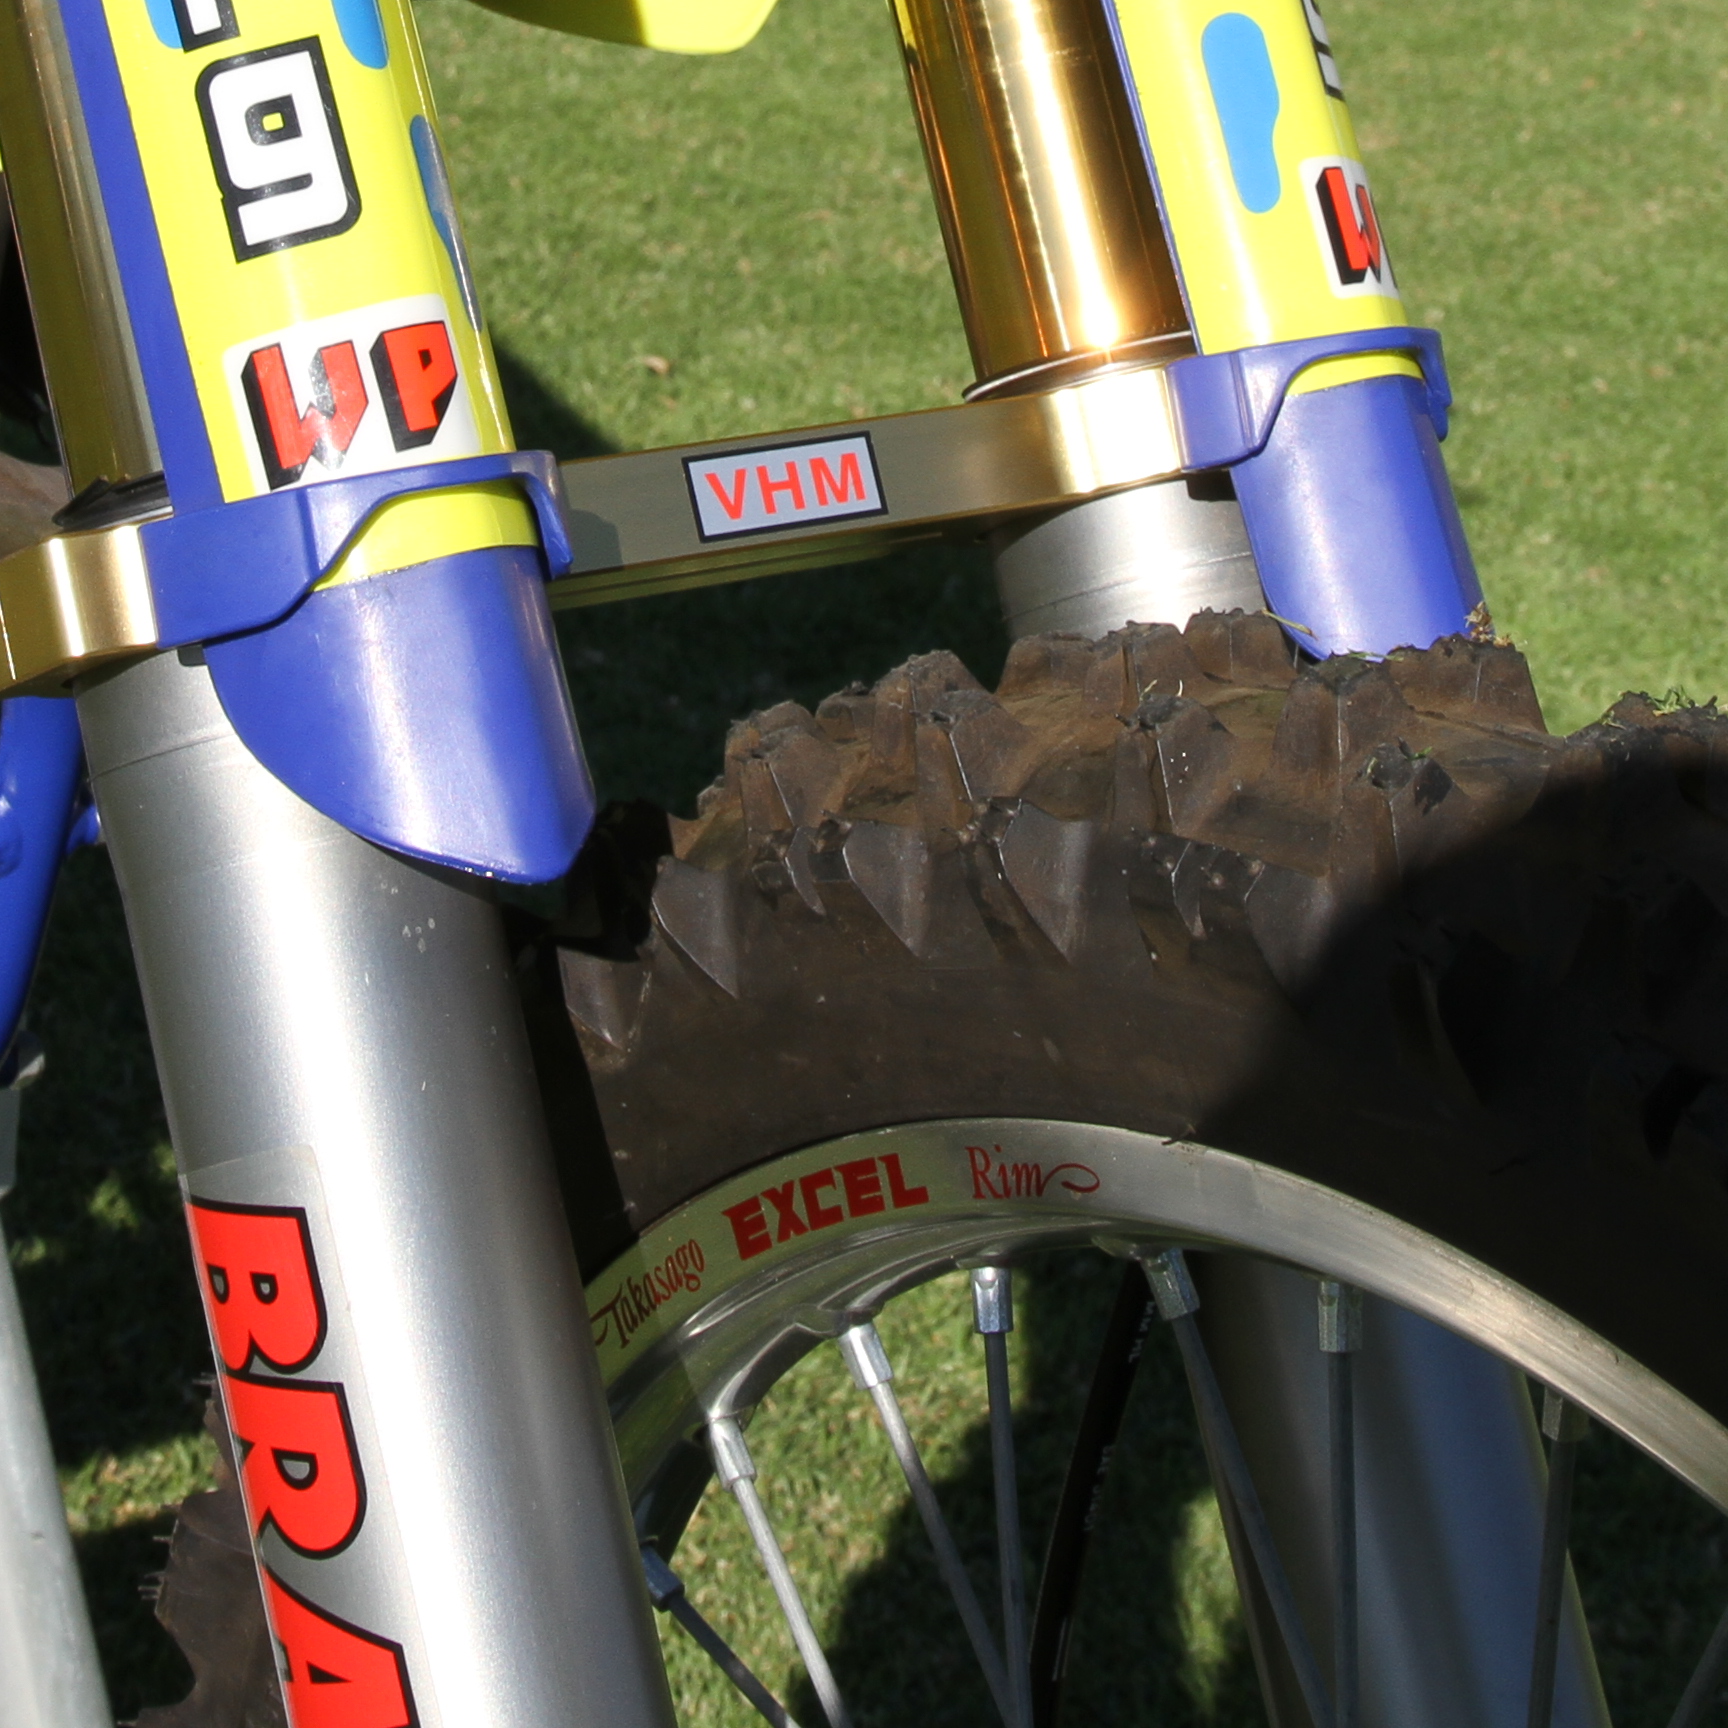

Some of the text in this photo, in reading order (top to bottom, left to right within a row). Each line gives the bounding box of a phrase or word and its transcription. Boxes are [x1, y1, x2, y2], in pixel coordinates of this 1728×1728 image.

[241, 320, 458, 491] WP
[704, 451, 868, 521] VHM
[721, 1152, 930, 1261] EXCEL
[965, 1144, 1101, 1201] Rim
[590, 1238, 706, 1350] Takasago
